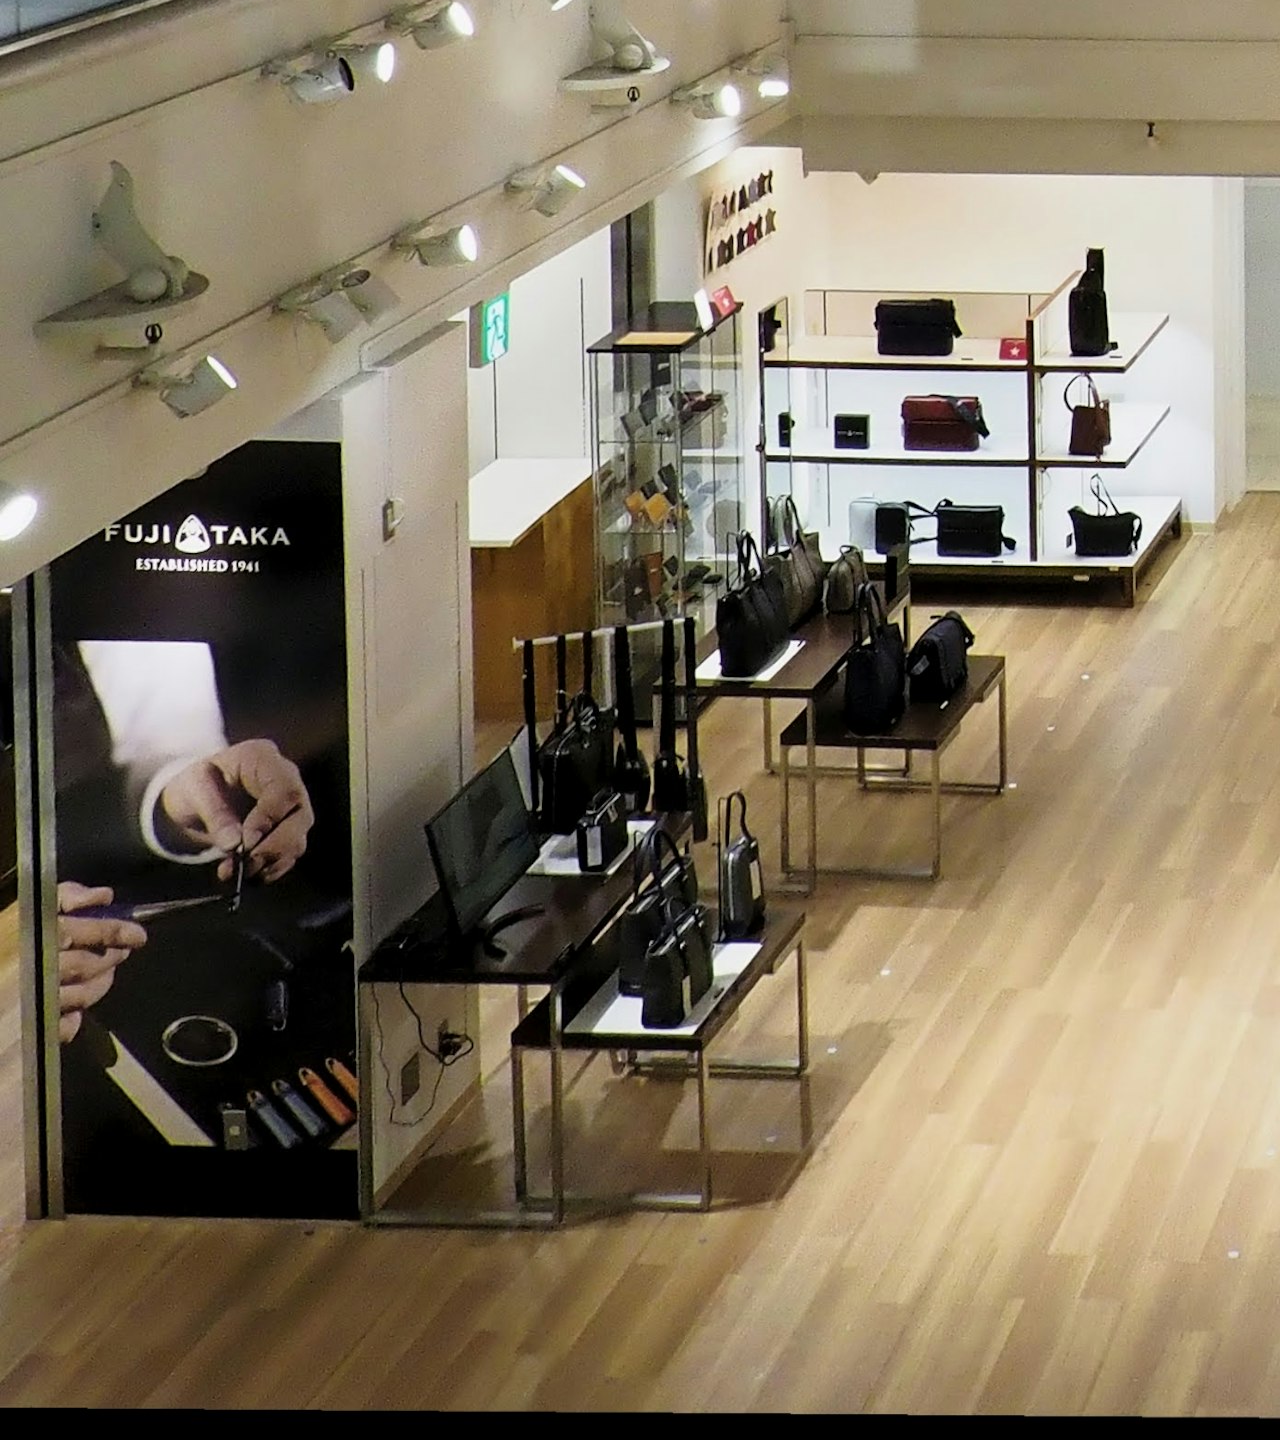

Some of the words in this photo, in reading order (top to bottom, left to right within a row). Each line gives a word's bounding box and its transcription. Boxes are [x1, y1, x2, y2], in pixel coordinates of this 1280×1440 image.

[104, 524, 171, 544] FUJI
[210, 525, 291, 546] TAKA
[136, 558, 229, 572] ESTABLISHED
[231, 560, 260, 573] 1941
